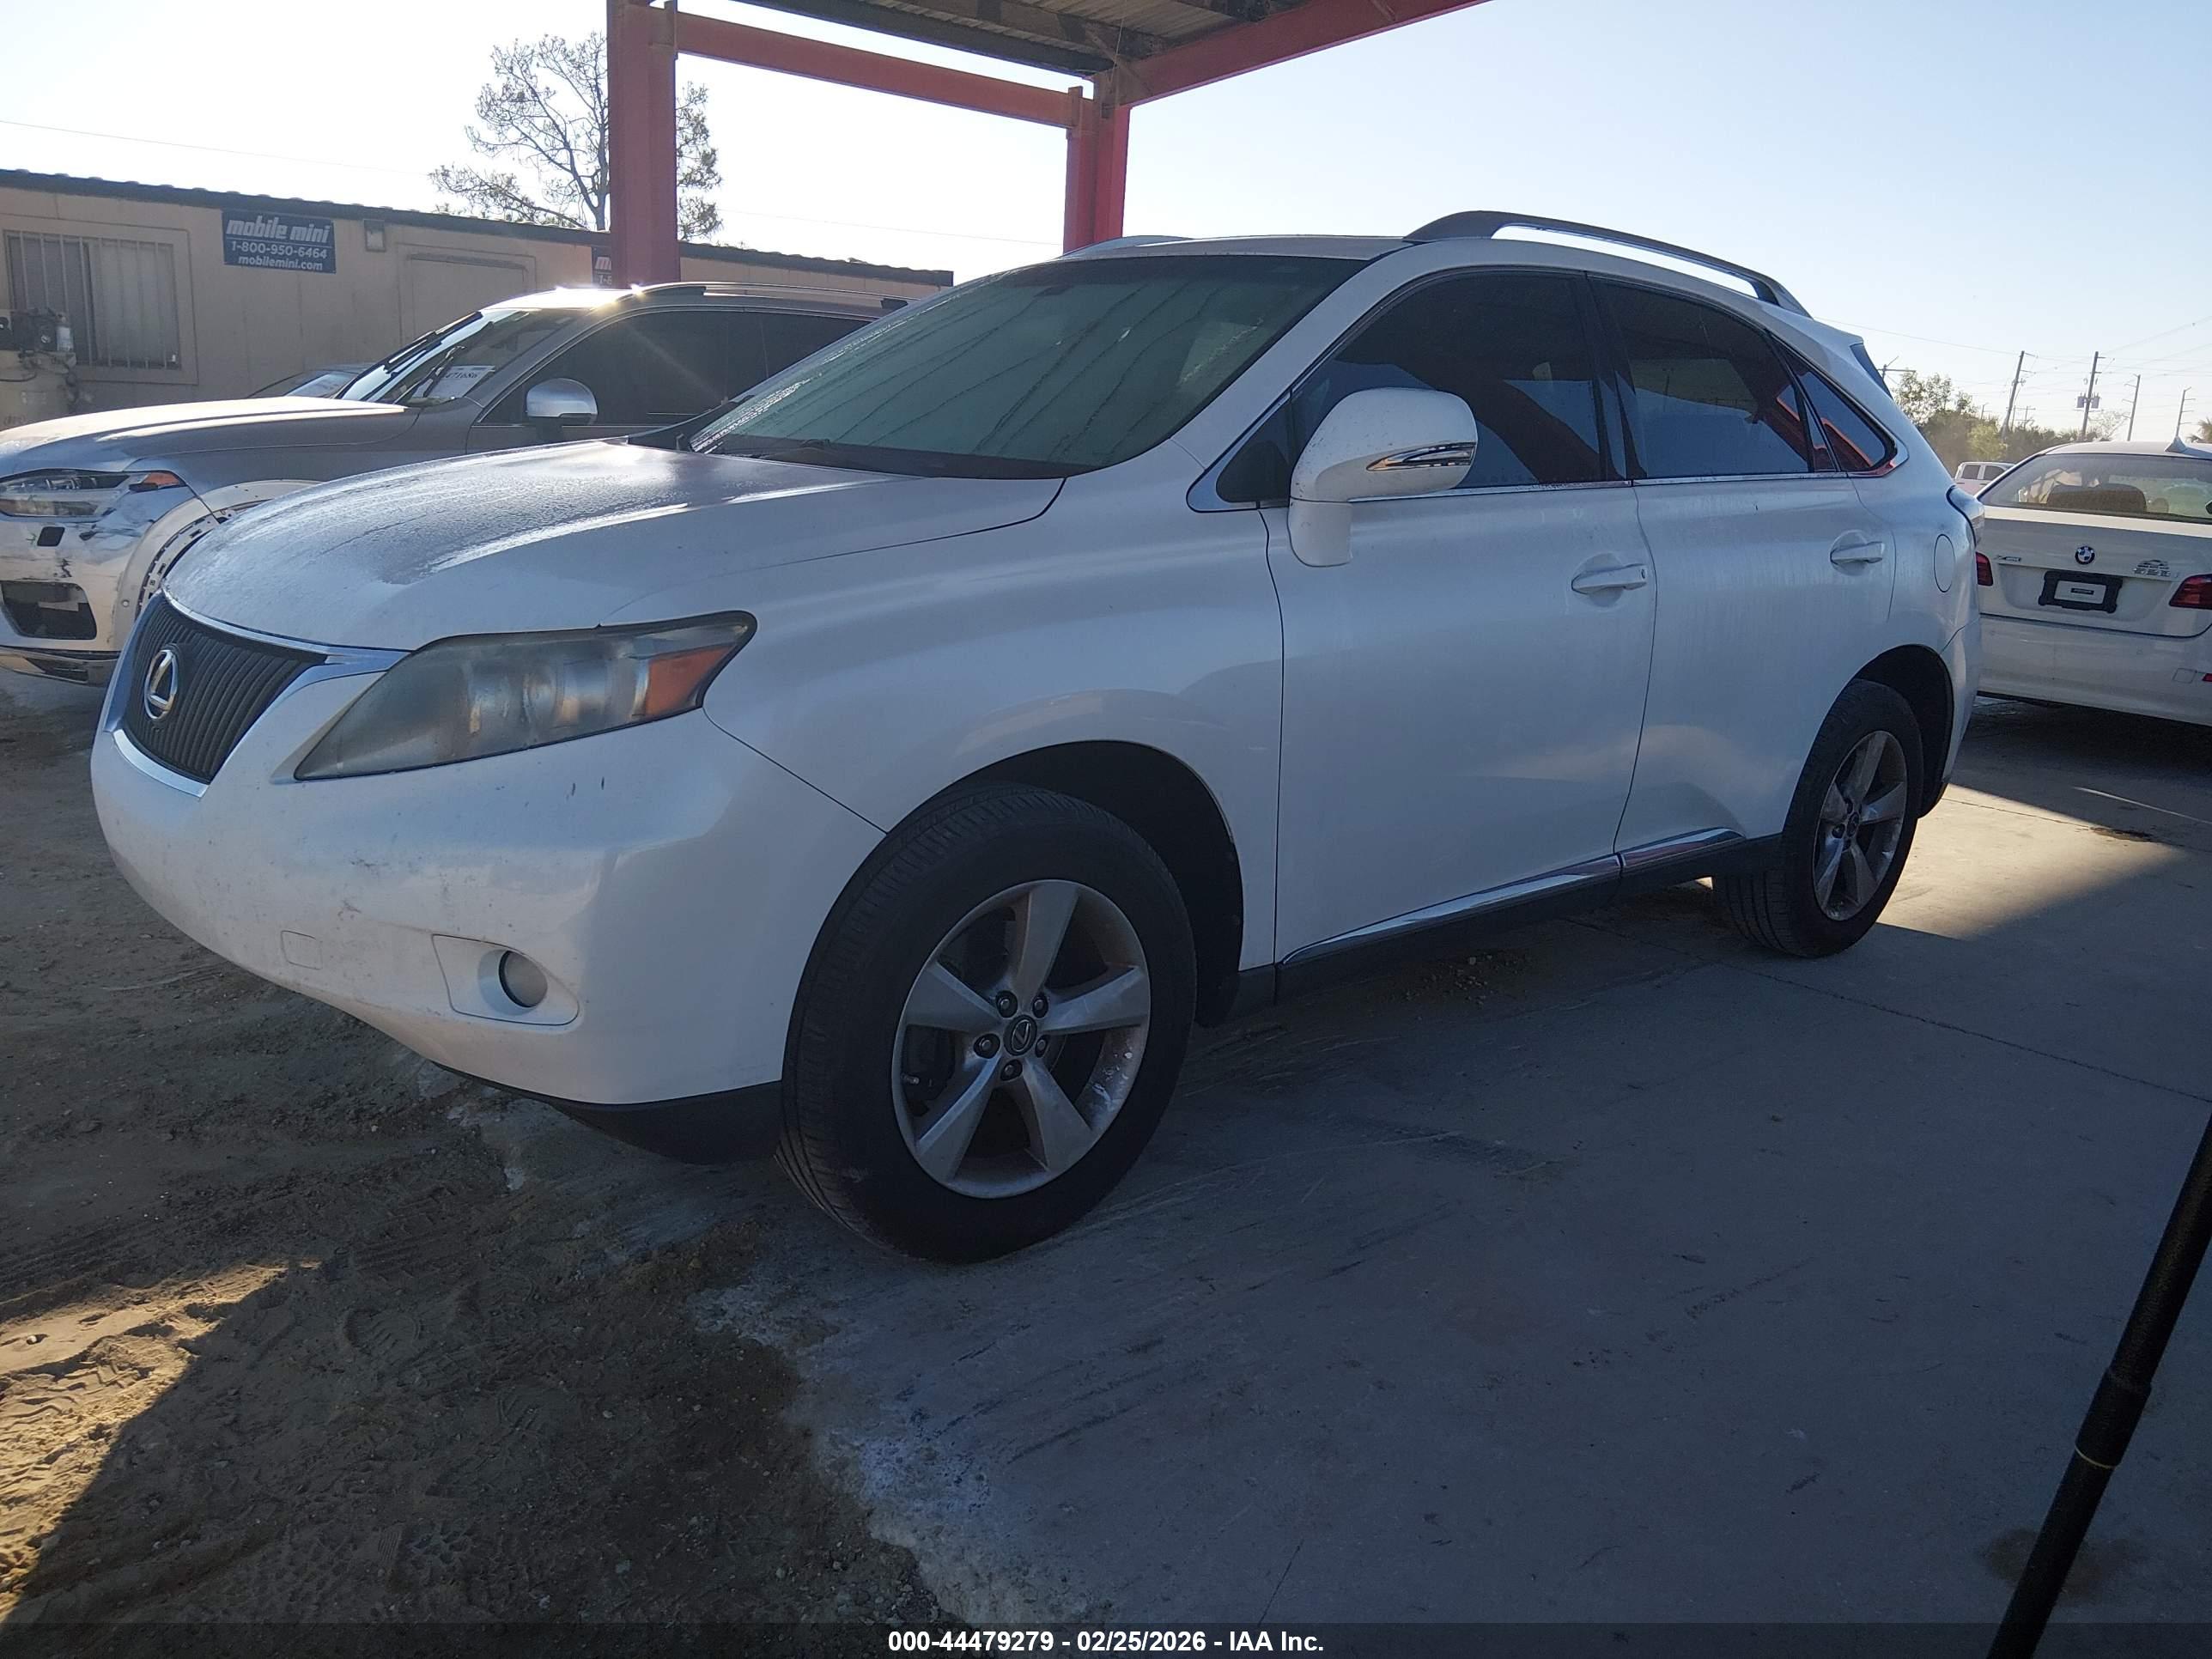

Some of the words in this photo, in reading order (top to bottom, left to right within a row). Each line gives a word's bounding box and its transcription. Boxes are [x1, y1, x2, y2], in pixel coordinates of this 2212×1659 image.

[225, 215, 289, 240] mobile
[289, 223, 331, 243] mini
[231, 240, 328, 259] 1-800-950-6464
[238, 255, 324, 270] mobilemini.com
